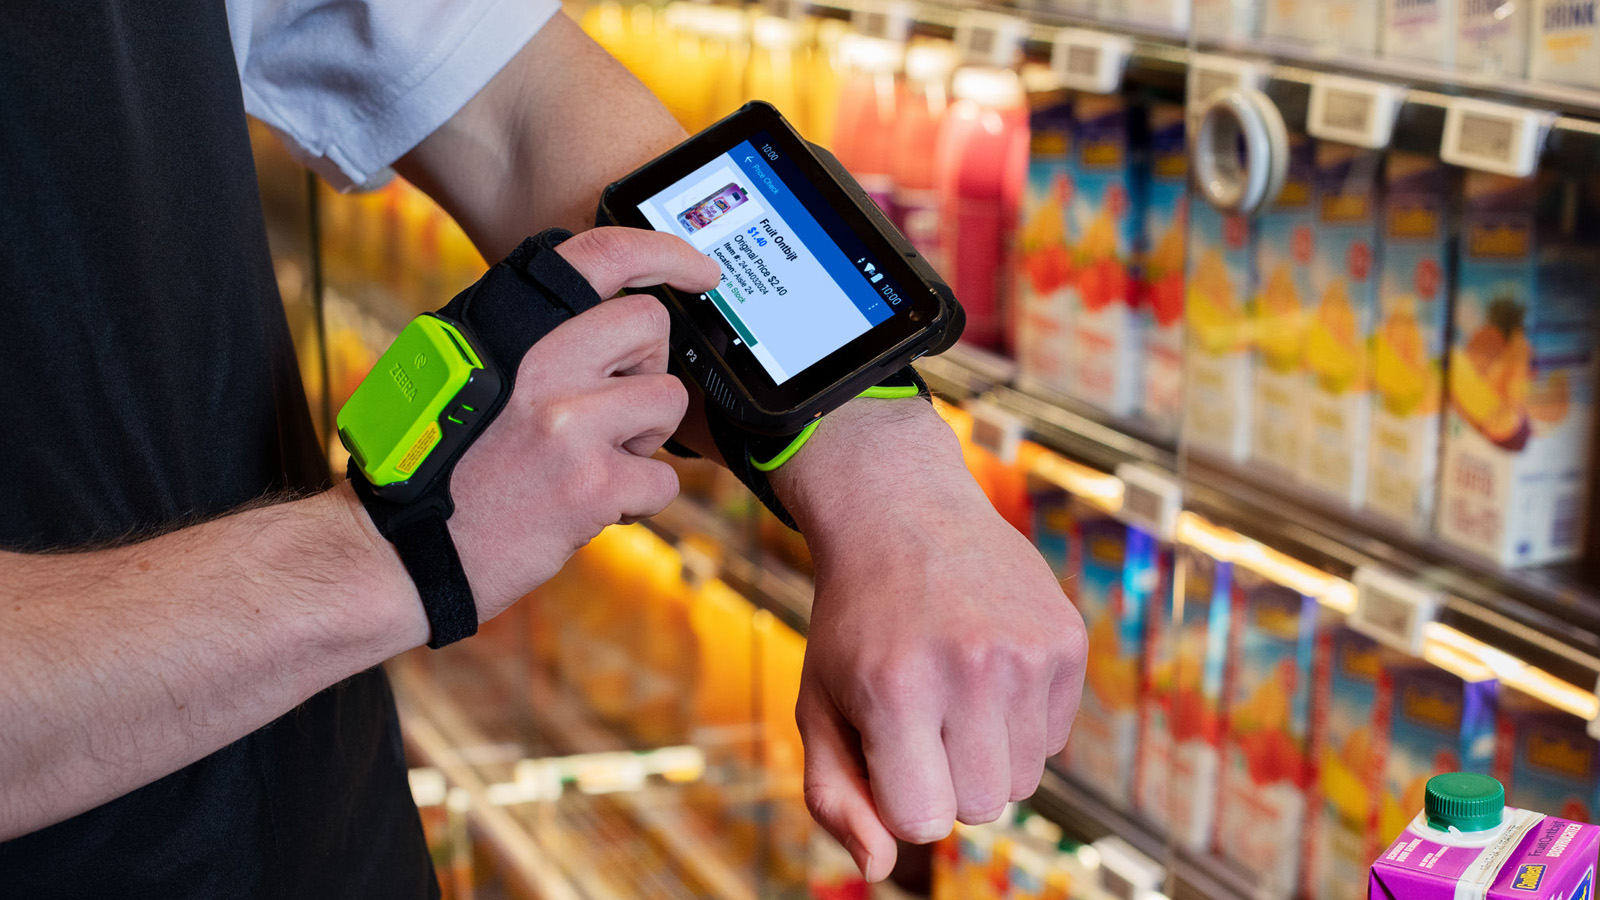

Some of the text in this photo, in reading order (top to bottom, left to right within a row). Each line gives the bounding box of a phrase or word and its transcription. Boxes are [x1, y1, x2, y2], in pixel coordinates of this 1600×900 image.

[762, 144, 778, 161] 10:00
[752, 164, 778, 194] Price Check
[747, 226, 768, 247] $1.40
[760, 218, 798, 262] Fruit Ontbijt
[723, 242, 736, 256] Item
[713, 247, 737, 274] Location:
[733, 273, 747, 287] Aisle
[744, 286, 754, 295] 24
[734, 234, 788, 296] Original Price $2.40
[726, 281, 746, 304] In Stock
[881, 284, 902, 305] 10:00
[686, 348, 698, 363] P3
[389, 362, 418, 403] ZEBRA
